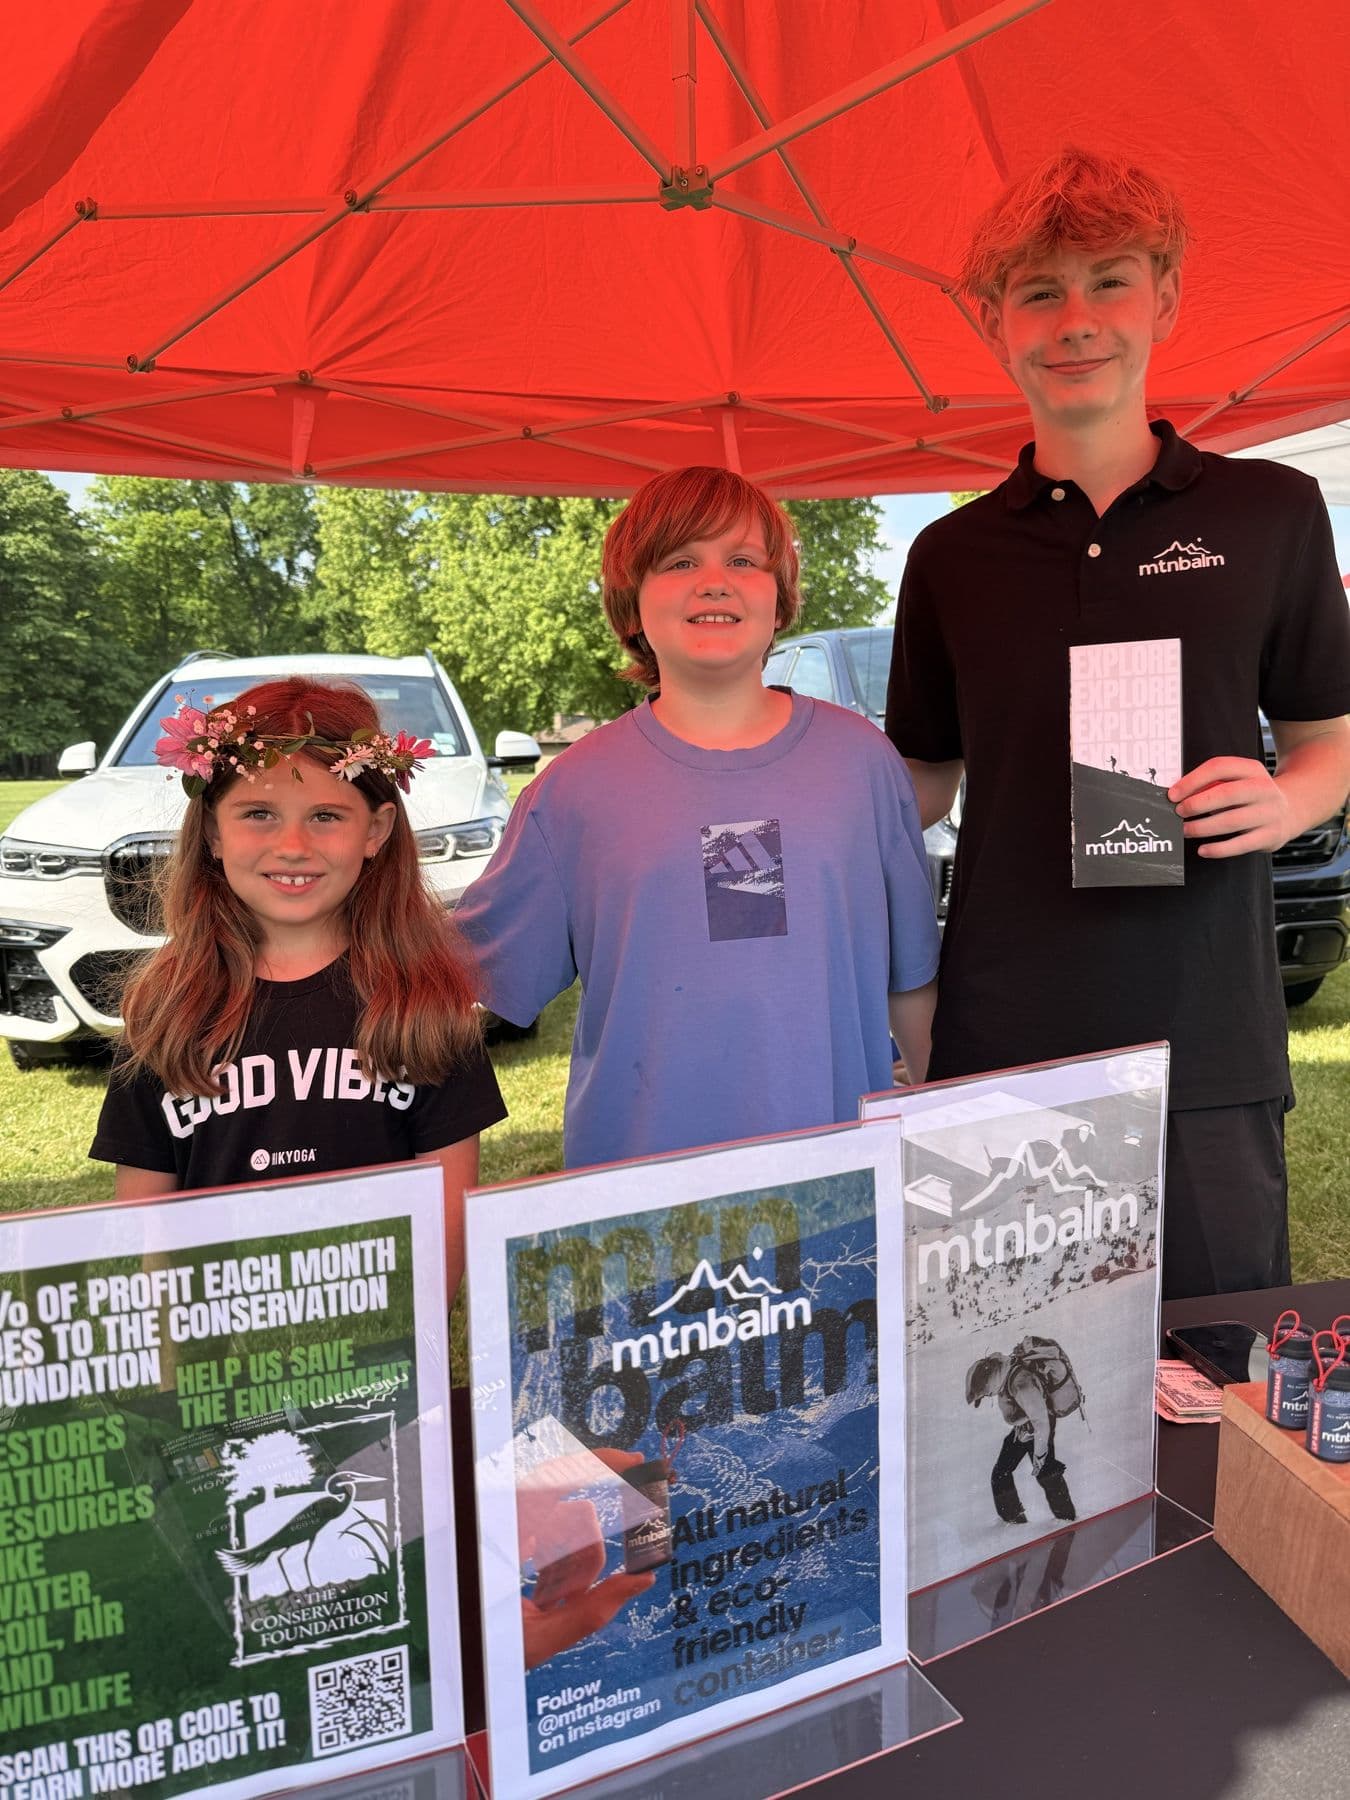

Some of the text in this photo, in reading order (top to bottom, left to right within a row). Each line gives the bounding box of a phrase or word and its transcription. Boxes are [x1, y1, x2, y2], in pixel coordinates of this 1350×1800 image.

[1138, 553, 1226, 577] mtnbalm
[1073, 643, 1178, 680] EXPLORE
[1073, 674, 1178, 712] EXPLORE
[1073, 707, 1178, 744] EXPLORE
[1085, 836, 1173, 857] mtnbalm
[917, 1190, 1138, 1285] mtnbalm
[37, 1282, 78, 1324] OF
[87, 1266, 195, 1317] PROFIT
[203, 1254, 283, 1299] EACH
[290, 1236, 397, 1288] MONTH
[0, 1274, 389, 1369] ES TO THE CONSERVATION
[611, 1295, 812, 1373] mtnbalm
[0, 1348, 162, 1409] UNDATION
[176, 1338, 355, 1397] HELP US SAVE
[177, 1360, 412, 1429] THE ENVIRONMENT
[672, 1469, 848, 1550] All natural
[670, 1506, 869, 1591] ingredients
[250, 1591, 389, 1633] CONSERVATION
[303, 1587, 337, 1605] THE
[672, 1576, 790, 1629] & eco-
[260, 1608, 383, 1648] FOUNDATION
[673, 1601, 807, 1670] friendly
[673, 1625, 842, 1706] container
[0, 1671, 132, 1734] WILDLIFE
[536, 1679, 602, 1716] Follow
[537, 1687, 641, 1737] @mtnbalm
[538, 1698, 661, 1753] on instagram
[0, 1691, 281, 1786] SCAN THIS QR CODE TO
[89, 1751, 166, 1795] MORE
[172, 1726, 250, 1774] ABOUT
[256, 1718, 287, 1751] IT!
